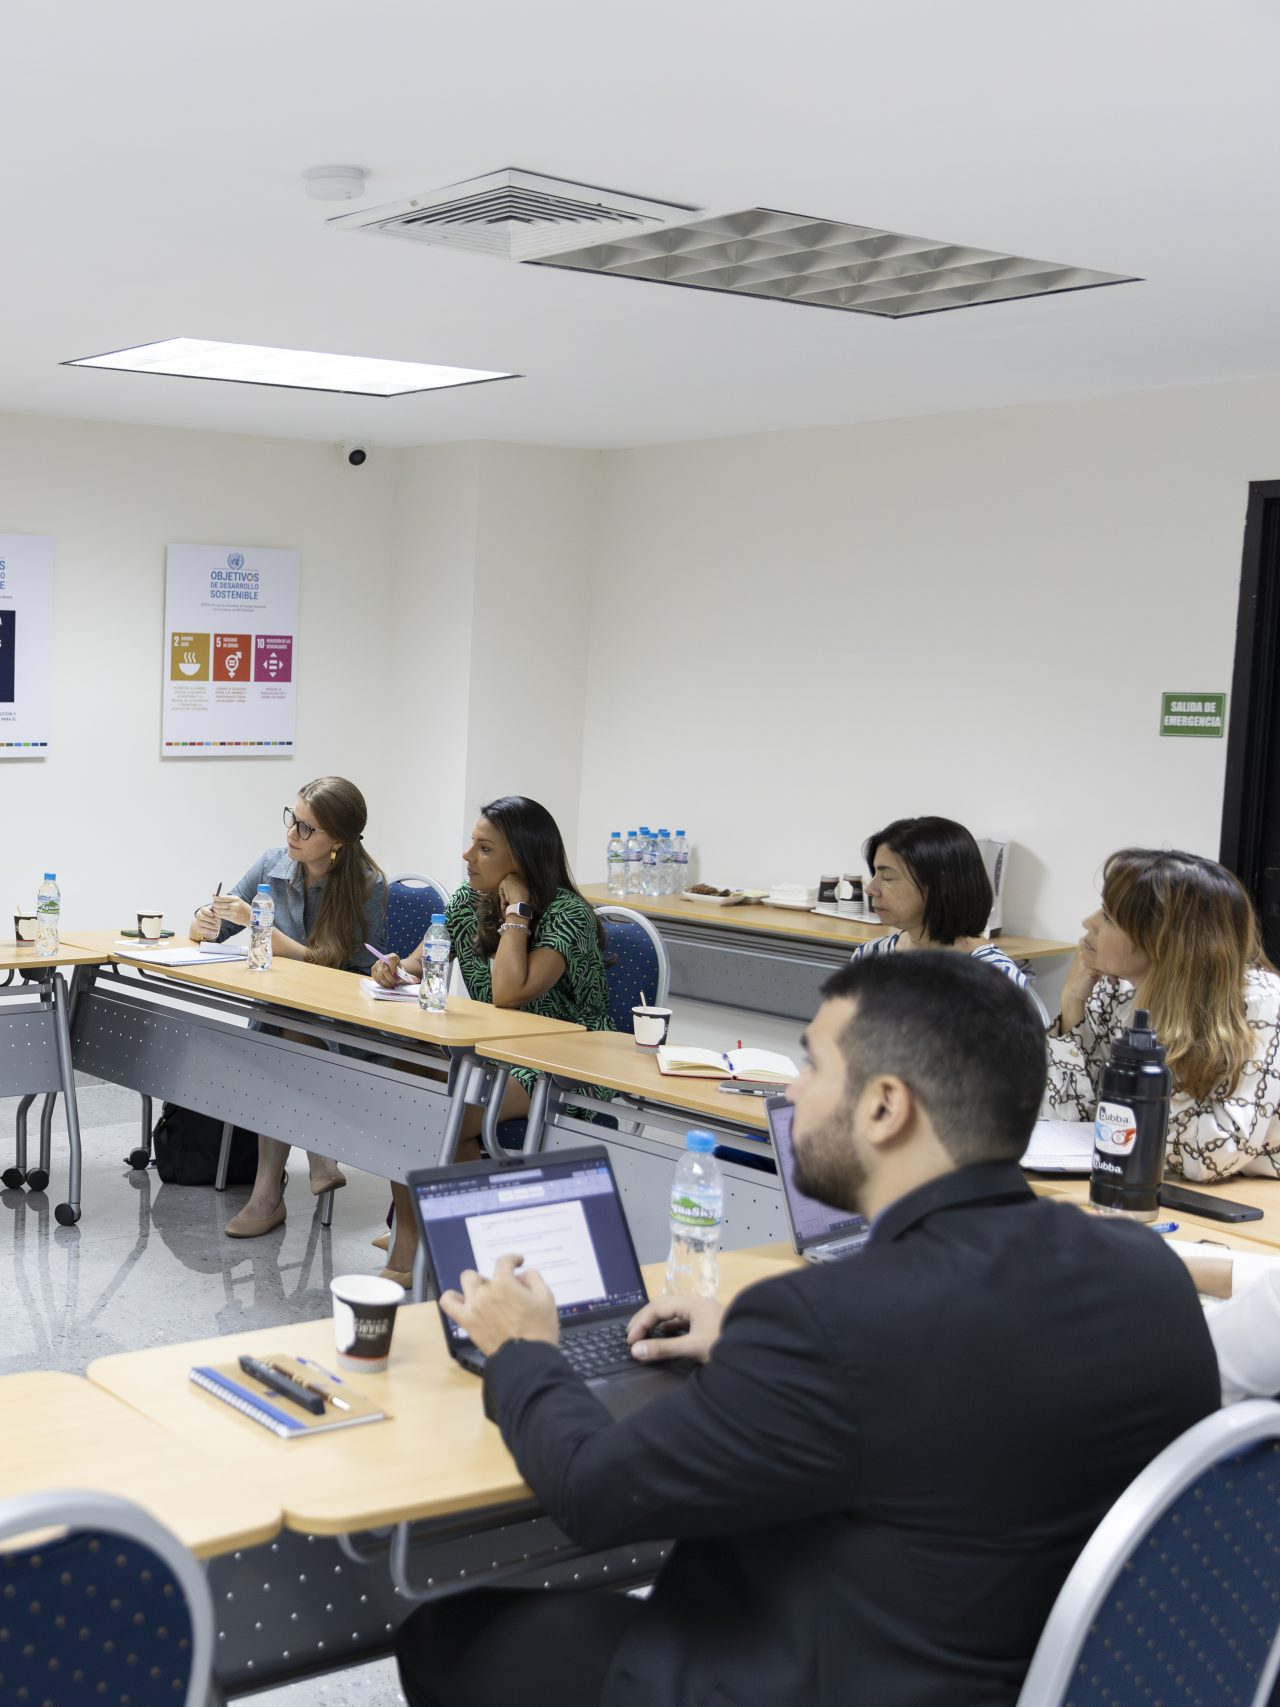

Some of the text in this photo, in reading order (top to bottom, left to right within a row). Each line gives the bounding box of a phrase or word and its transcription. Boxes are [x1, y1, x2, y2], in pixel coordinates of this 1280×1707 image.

[210, 570, 259, 582] OBJETIVOS
[210, 590, 259, 600] SOSTENIBLE
[174, 636, 179, 647] 2
[216, 637, 221, 648] 5
[257, 638, 265, 649] 10
[1171, 701, 1216, 712] SALIDA DE
[1164, 715, 1221, 727] EMERGENCIA
